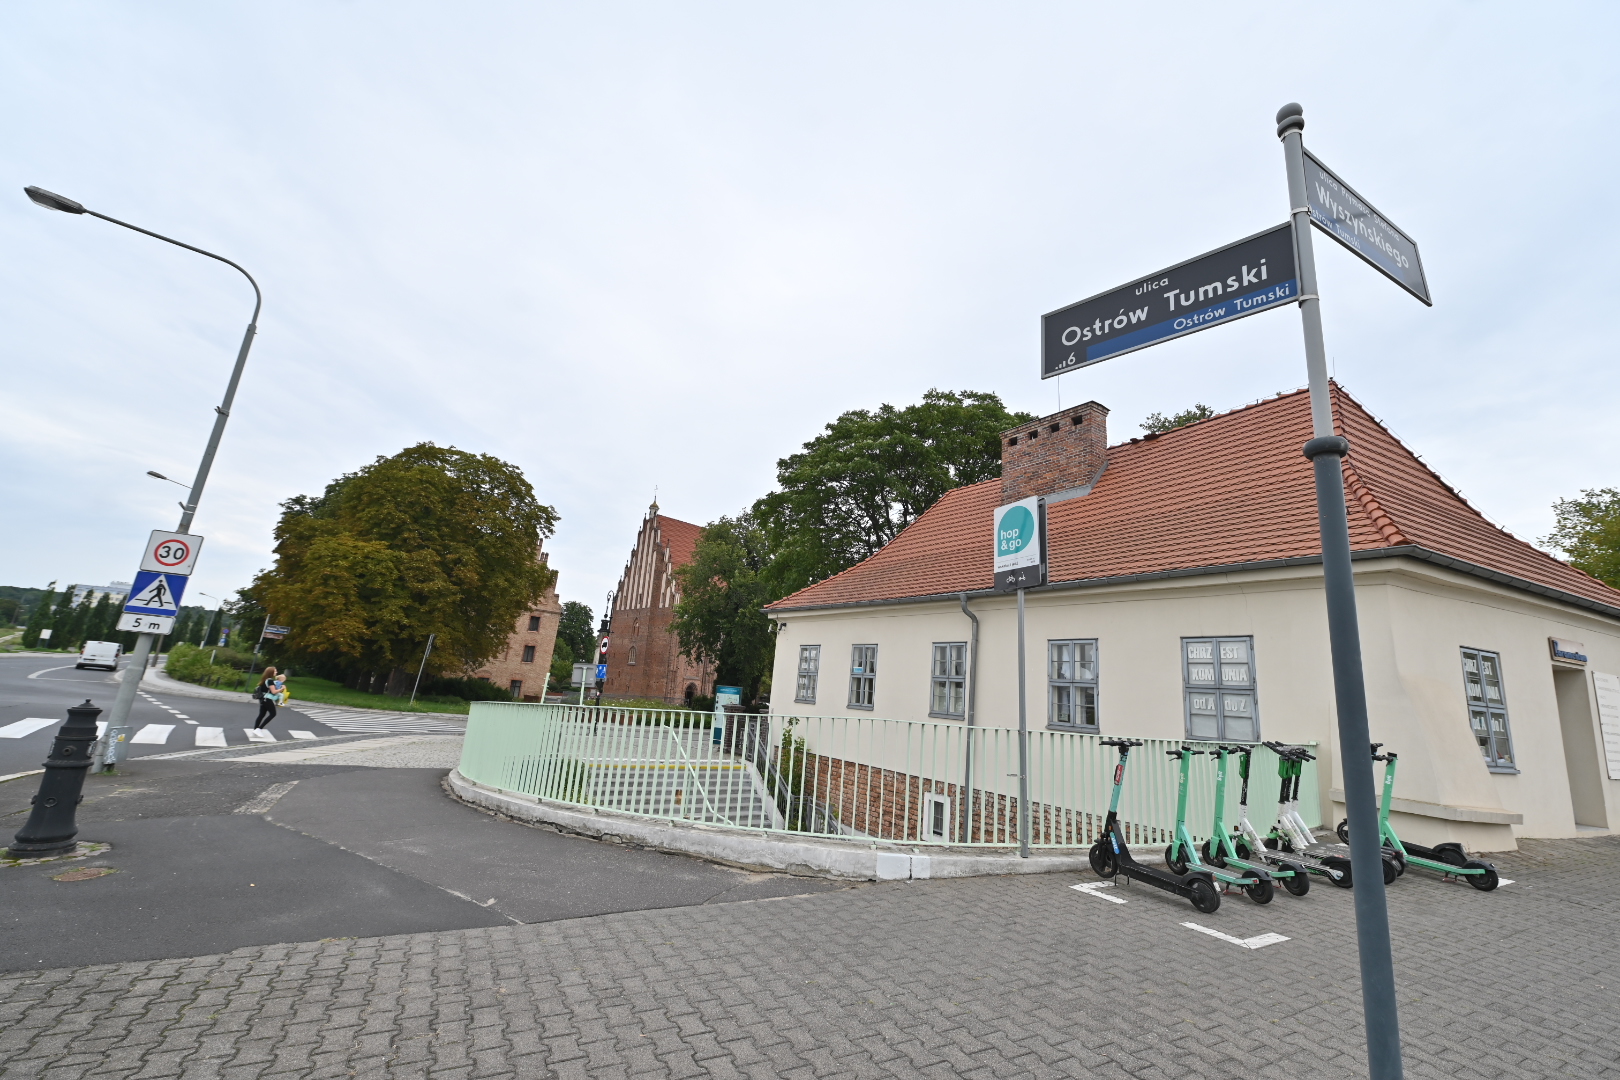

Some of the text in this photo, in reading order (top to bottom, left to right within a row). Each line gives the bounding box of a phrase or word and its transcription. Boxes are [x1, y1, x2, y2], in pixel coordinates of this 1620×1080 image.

[1319, 171, 1400, 242] ulica Prymasa Stefana
[1315, 181, 1409, 268] Wyszyńskiego
[1335, 223, 1361, 250] Tumski
[1135, 278, 1169, 295] ulica
[1061, 258, 1268, 346] Ostrów Tumski
[1173, 283, 1290, 330] Ostrów Tumski
[1001, 528, 1019, 539] hop
[159, 545, 185, 560] 30
[1001, 539, 1021, 550] & go
[132, 618, 160, 630] 5 m
[1194, 698, 1246, 711] od A do Z
